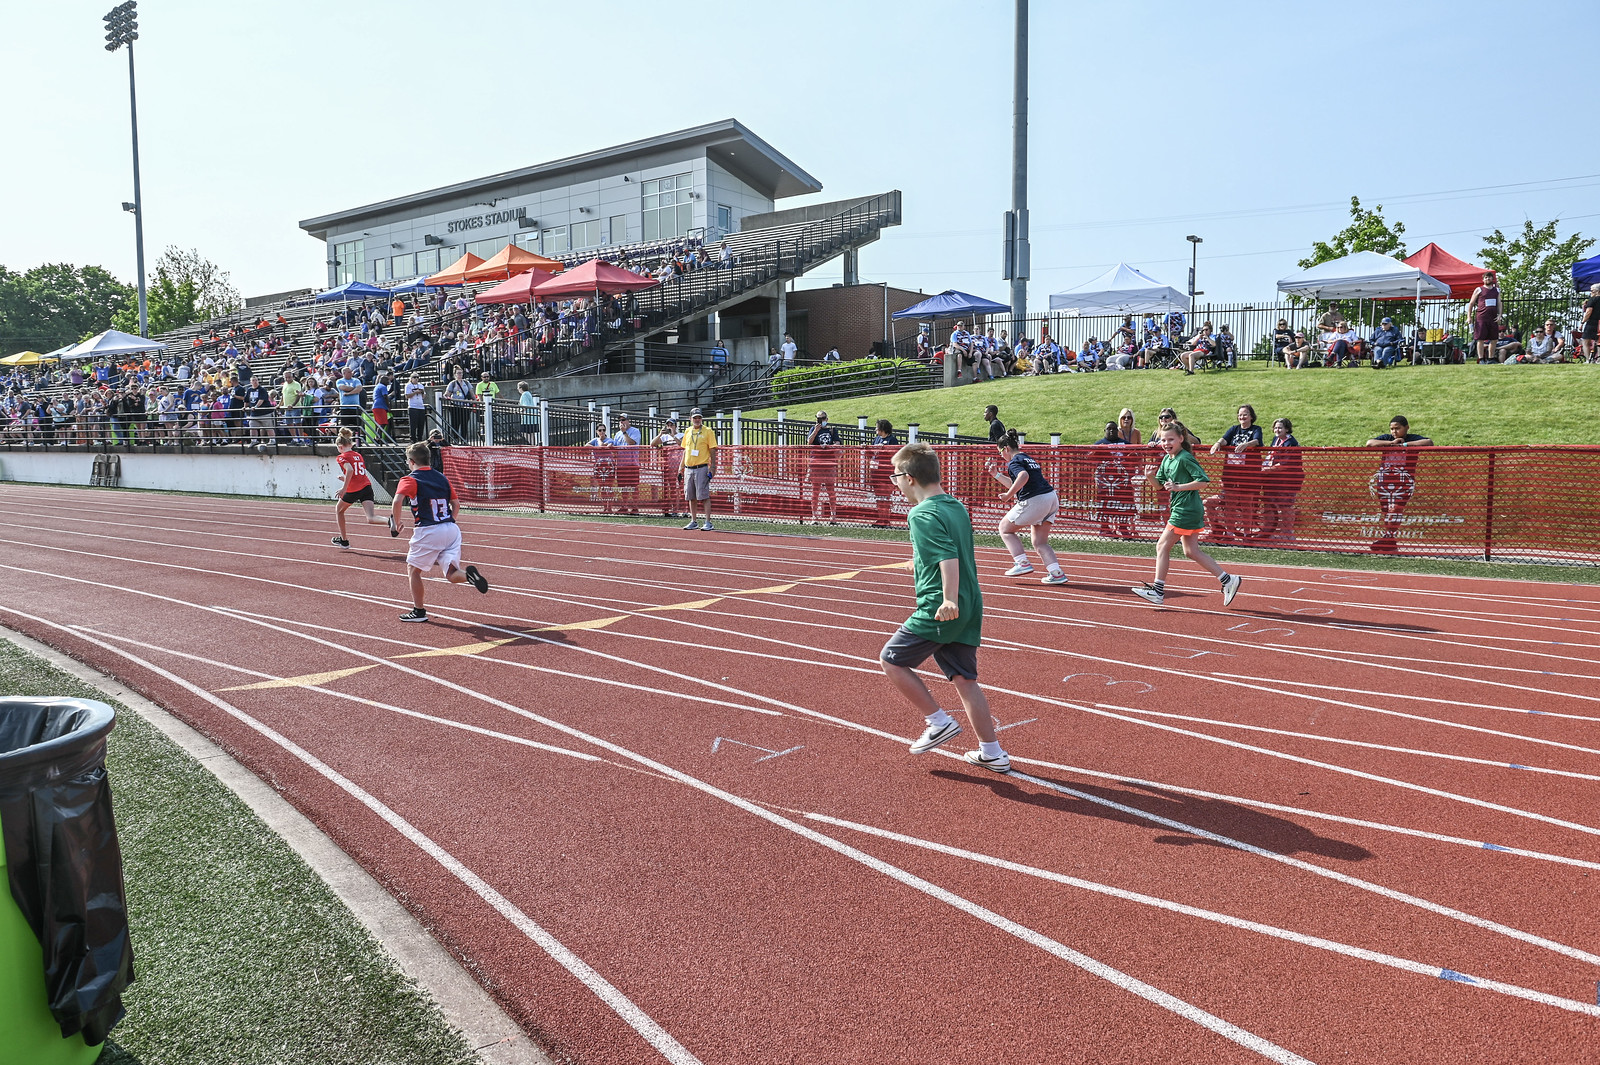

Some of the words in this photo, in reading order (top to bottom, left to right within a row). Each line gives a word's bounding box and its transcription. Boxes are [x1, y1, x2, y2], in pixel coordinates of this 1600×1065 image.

[448, 215, 483, 233] STOKES
[485, 207, 526, 226] STADIUM
[353, 461, 365, 476] 15
[430, 498, 451, 521] 13
[1059, 498, 1104, 509] Special
[1106, 500, 1167, 513] Olympics
[1321, 511, 1380, 523] Special
[1384, 512, 1465, 526] Olympics
[1359, 526, 1425, 539] Missouri
[1226, 622, 1296, 637] 5
[1062, 672, 1156, 694] 3
